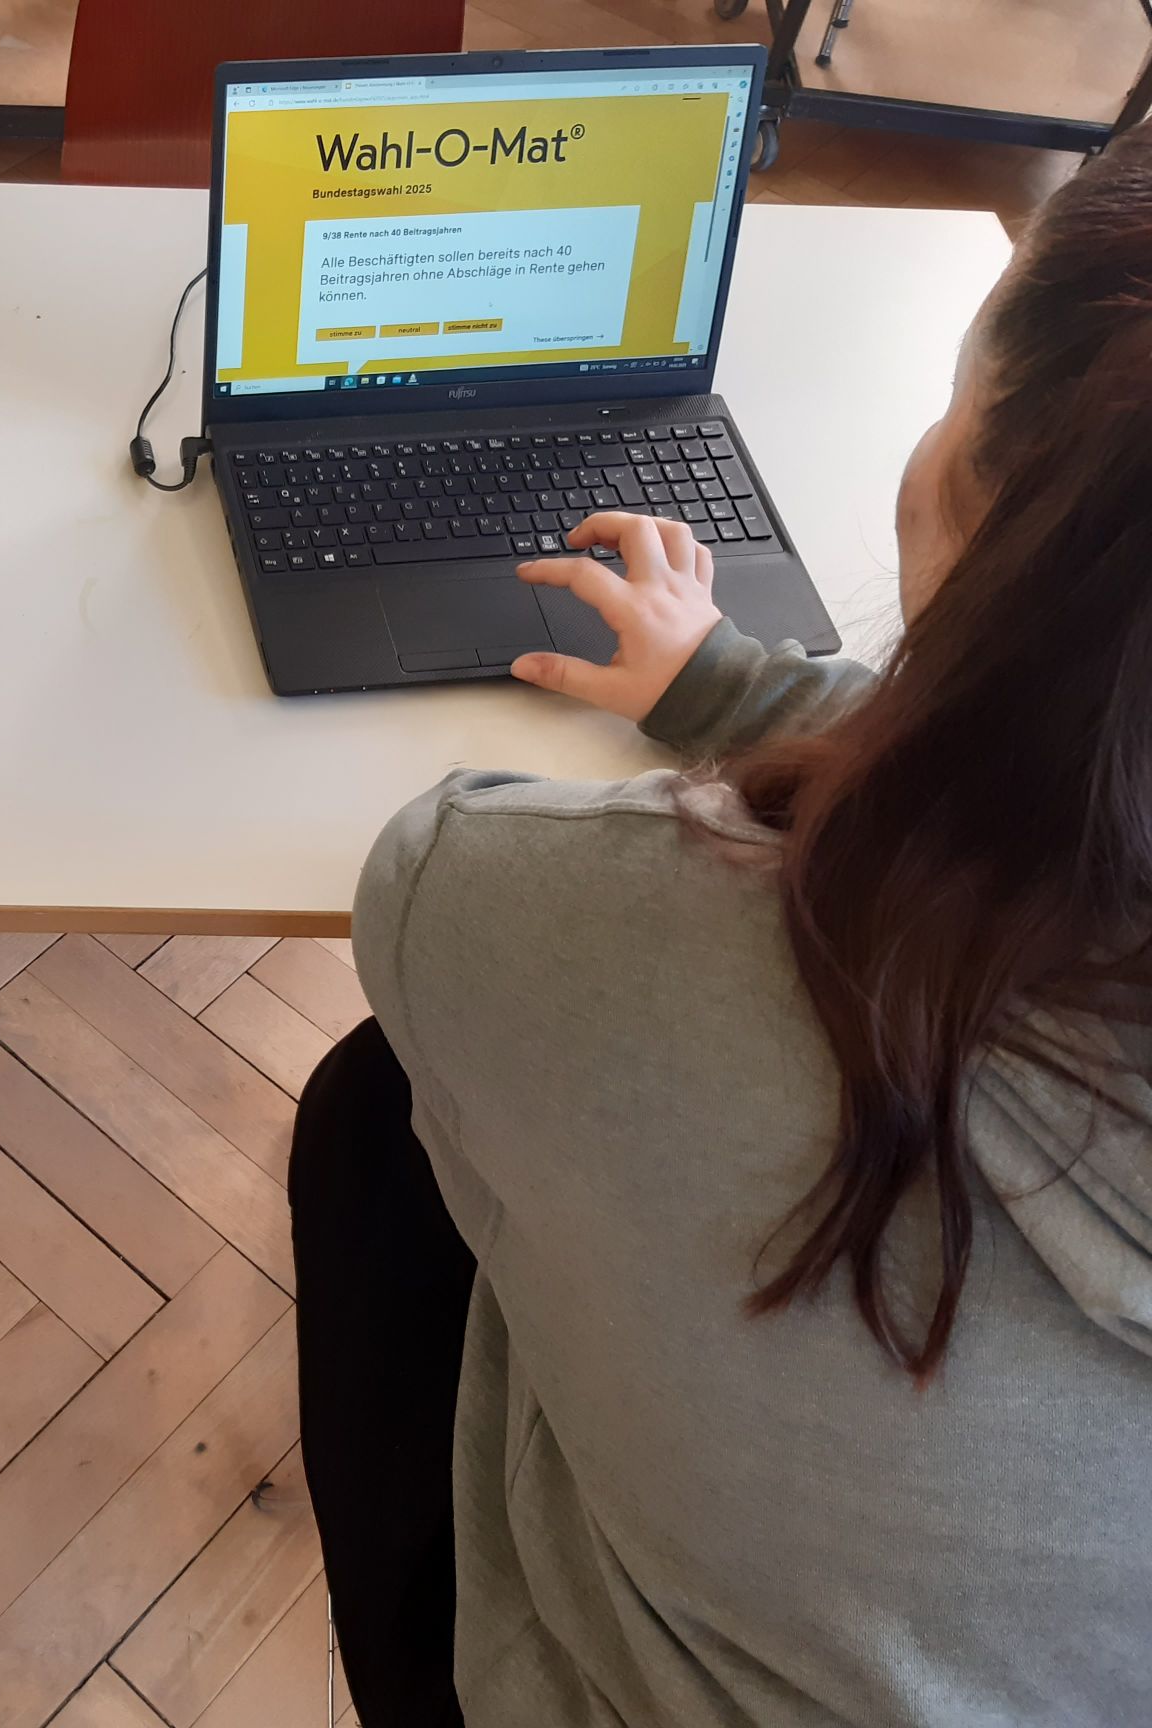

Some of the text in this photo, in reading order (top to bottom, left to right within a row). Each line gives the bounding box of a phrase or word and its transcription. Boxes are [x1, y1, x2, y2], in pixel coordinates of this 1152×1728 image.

[313, 184, 432, 199] Bundestagswahl 2025
[322, 227, 462, 240] 9/38 Rente nach 40 Beitragsjahren
[321, 244, 572, 268] Alle Beschäftigten sollen bereits nach 40
[320, 260, 605, 286] Beitragsjahren ohne Abschläge in Rente gehen
[319, 290, 367, 302] können.
[448, 386, 476, 400] FUJITSU
